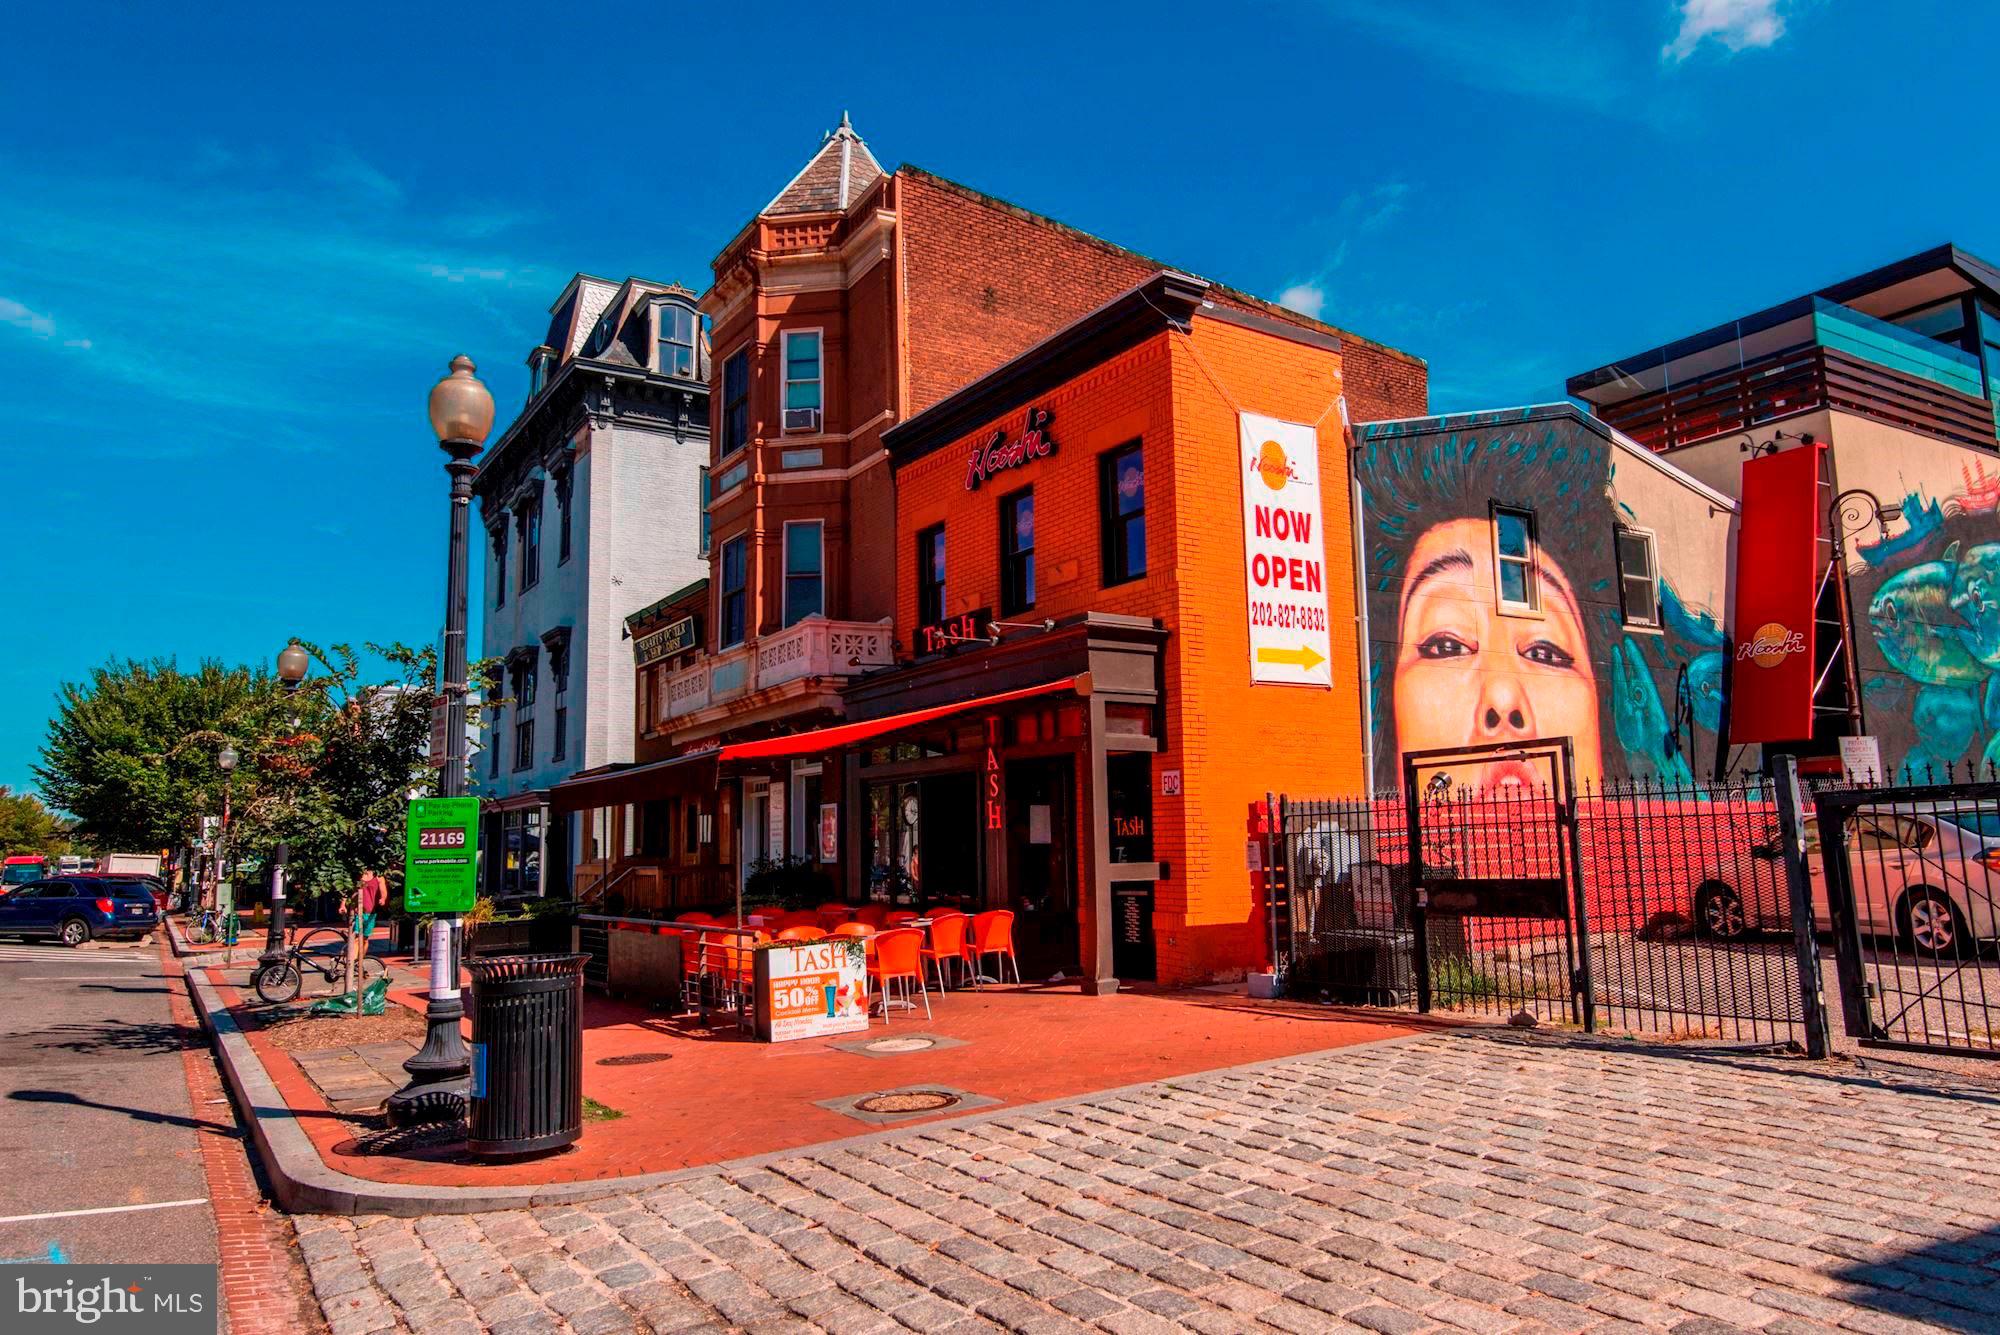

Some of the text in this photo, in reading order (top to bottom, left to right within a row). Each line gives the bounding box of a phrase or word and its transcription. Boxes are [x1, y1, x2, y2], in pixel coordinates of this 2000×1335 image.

[965, 407, 1050, 490] Nooshi
[1255, 504, 1311, 543] NOW
[1252, 553, 1321, 592] OPEN
[1252, 602, 1325, 632] 202-827-8832
[923, 615, 976, 652] TASH
[1737, 630, 1806, 661] Nooshi
[986, 716, 1002, 829] TASH
[1163, 775, 1178, 790] FDC
[420, 832, 465, 846] 21169
[1114, 816, 1144, 836] TASH
[790, 942, 847, 972] TASH
